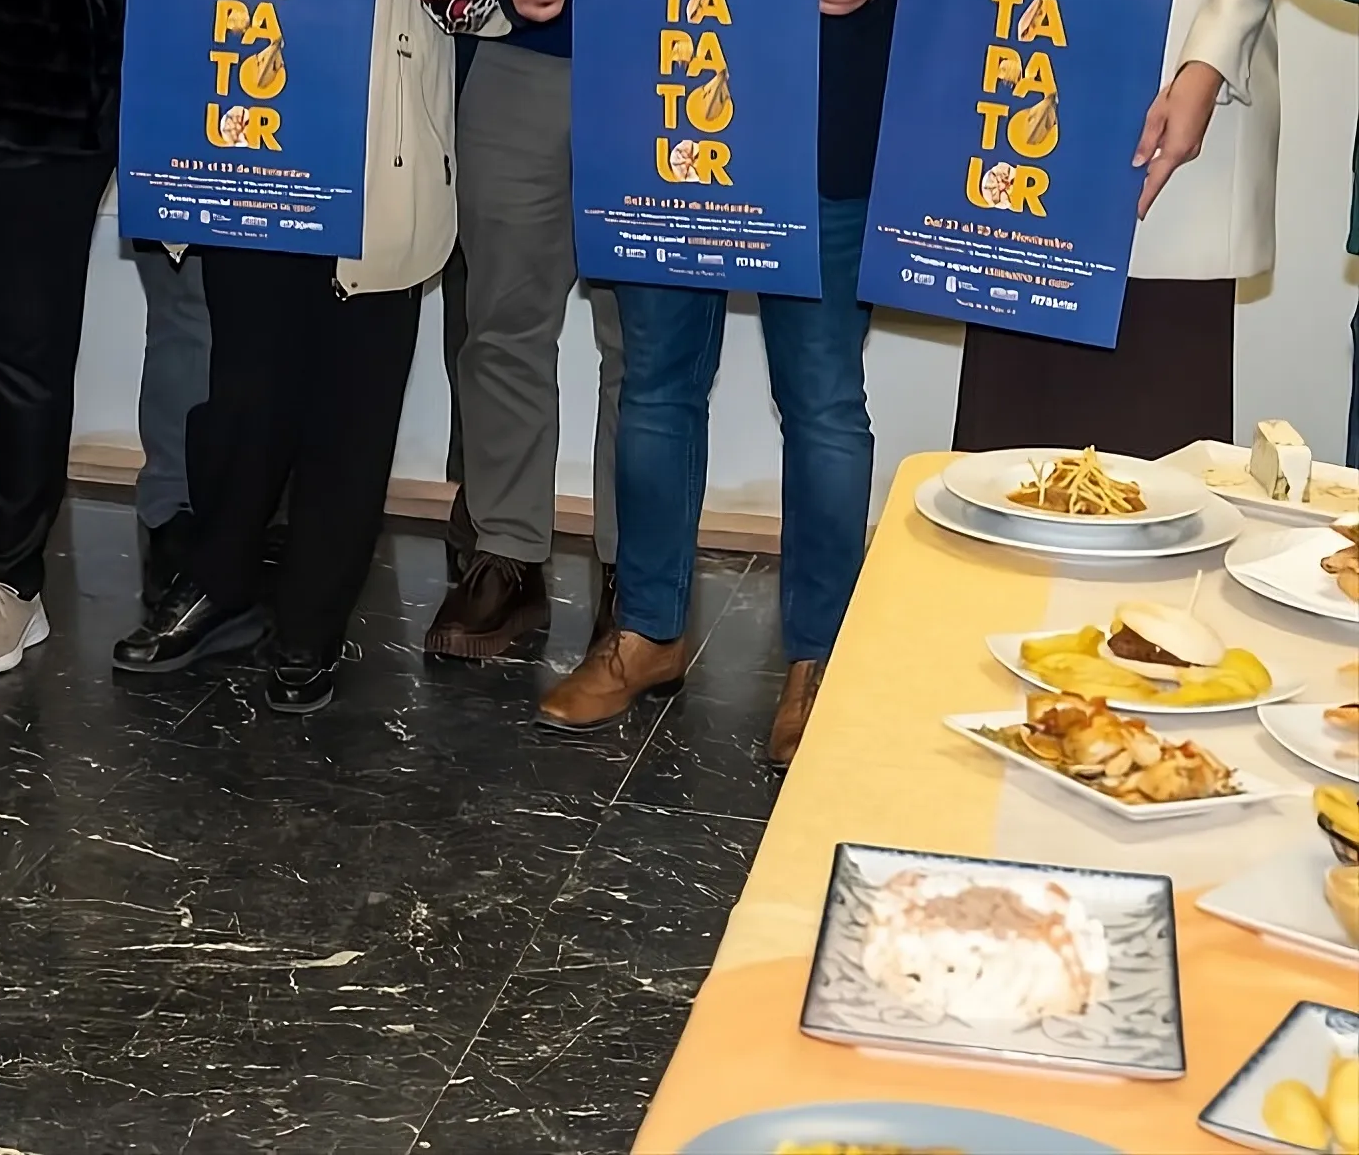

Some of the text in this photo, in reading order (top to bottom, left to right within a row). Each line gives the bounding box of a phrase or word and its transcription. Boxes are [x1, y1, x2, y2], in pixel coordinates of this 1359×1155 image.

[209, 41, 287, 99] TO
[660, 29, 729, 77] PA
[982, 44, 1058, 98] PA
[655, 75, 735, 133] TO
[976, 93, 1059, 159] TO
